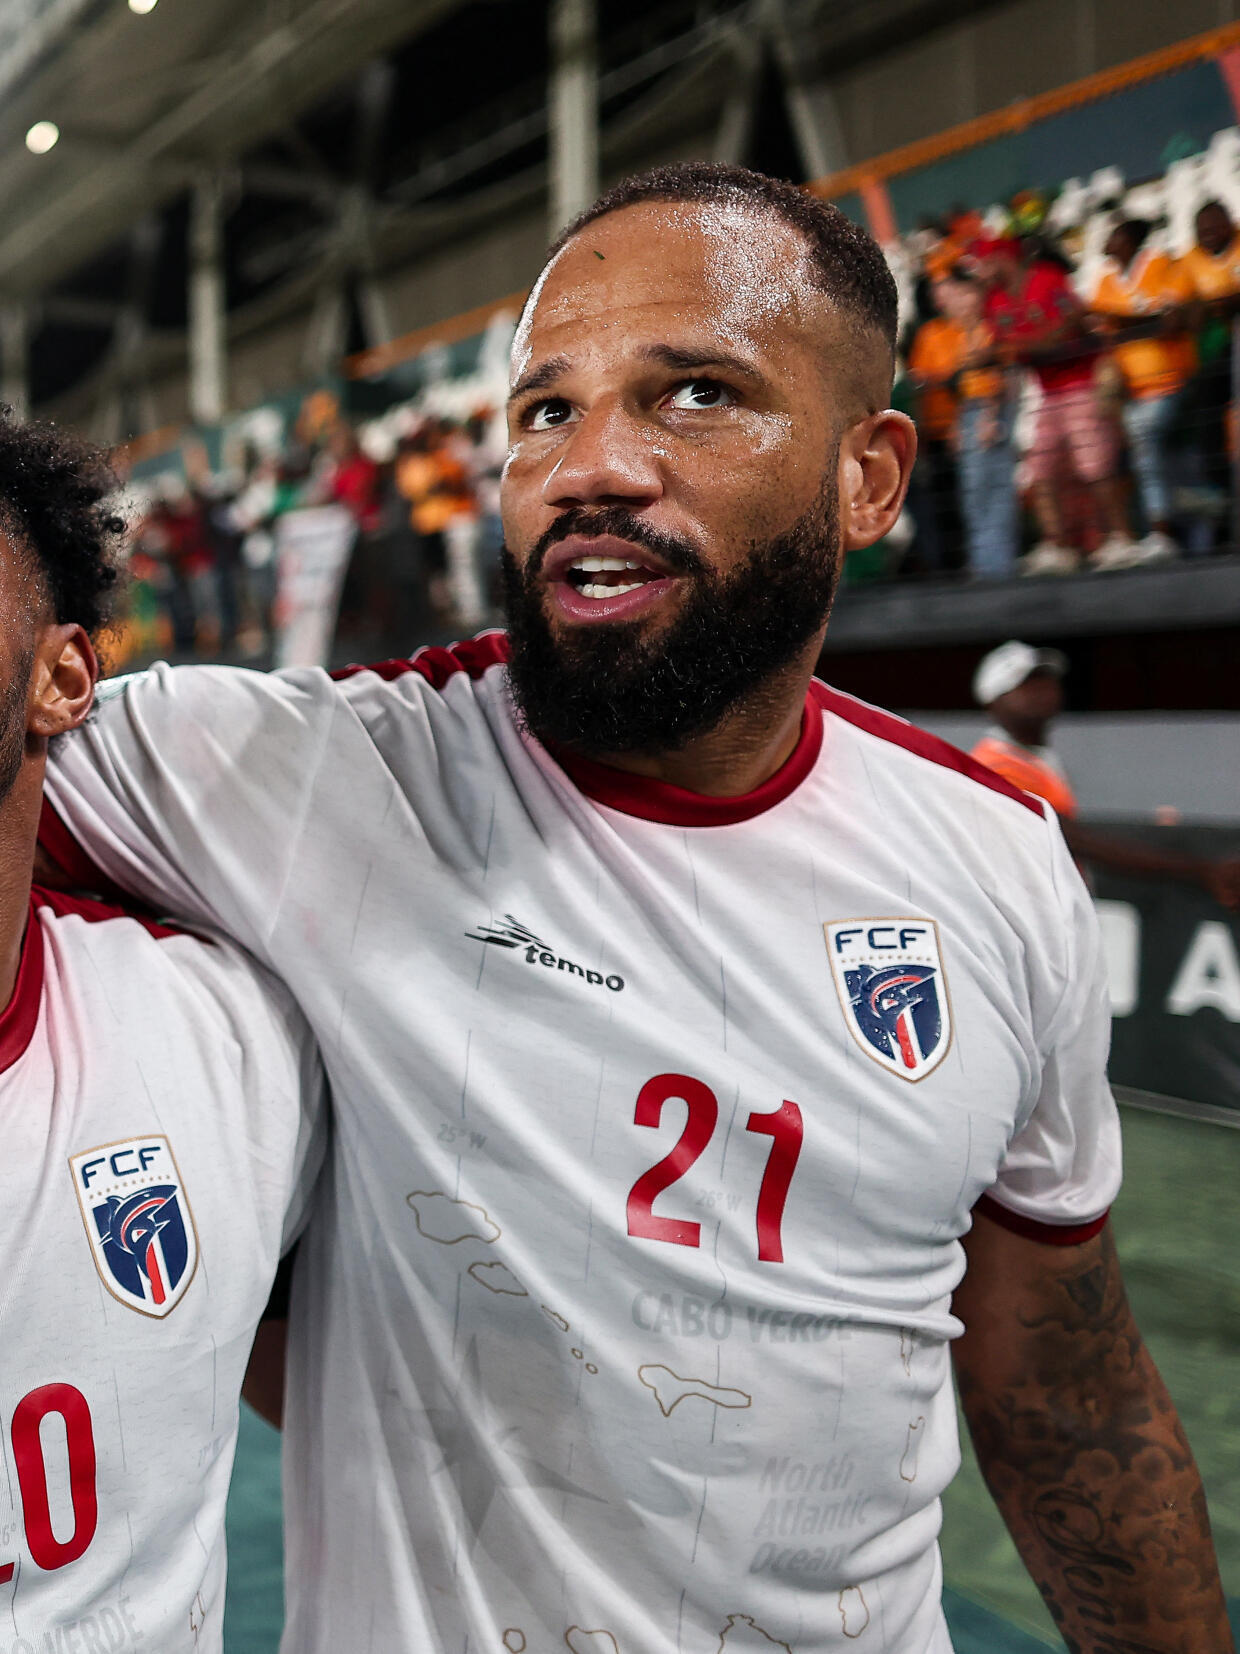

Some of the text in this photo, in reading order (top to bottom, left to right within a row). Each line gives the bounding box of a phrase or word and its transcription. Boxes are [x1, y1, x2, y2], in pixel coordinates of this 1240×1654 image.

[835, 927, 927, 953] FCF
[524, 945, 625, 992] tempo
[81, 1146, 161, 1189] FCF
[626, 1073, 803, 1263] 21
[631, 1289, 733, 1341] CABO
[759, 1453, 855, 1493] North
